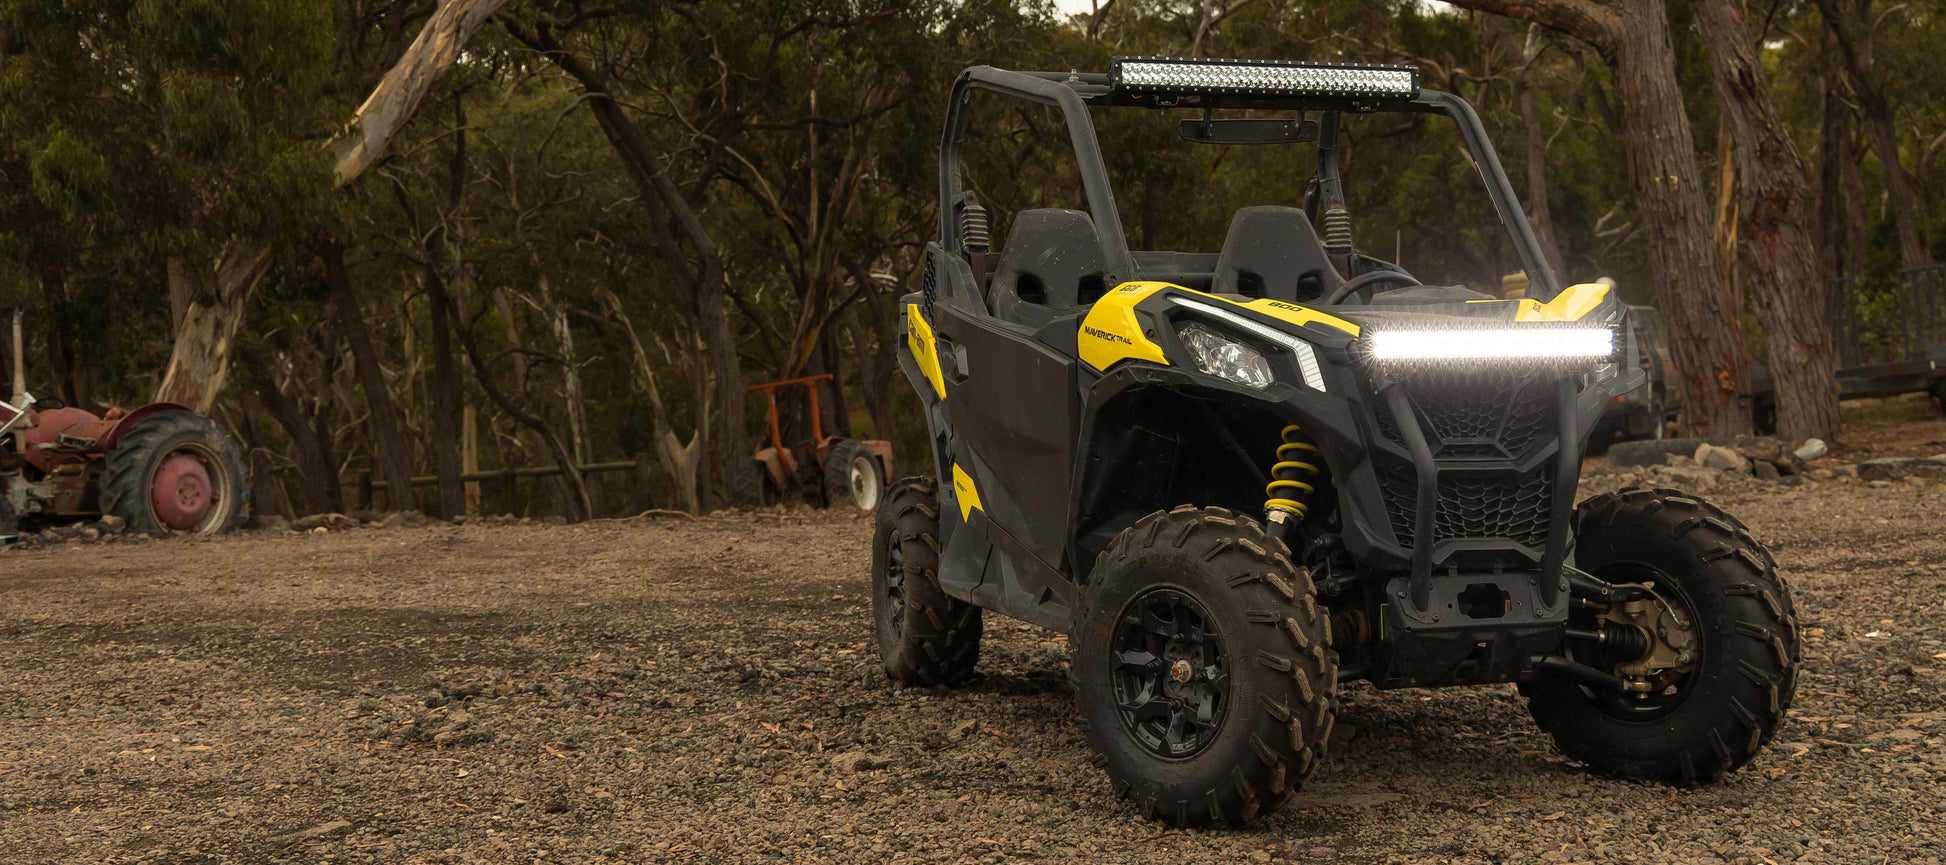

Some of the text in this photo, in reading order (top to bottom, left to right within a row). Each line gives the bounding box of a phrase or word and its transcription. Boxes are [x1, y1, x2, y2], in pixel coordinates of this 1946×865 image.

[1268, 302, 1303, 312] 800
[1084, 325, 1132, 345] MAVERICK TRAIL
